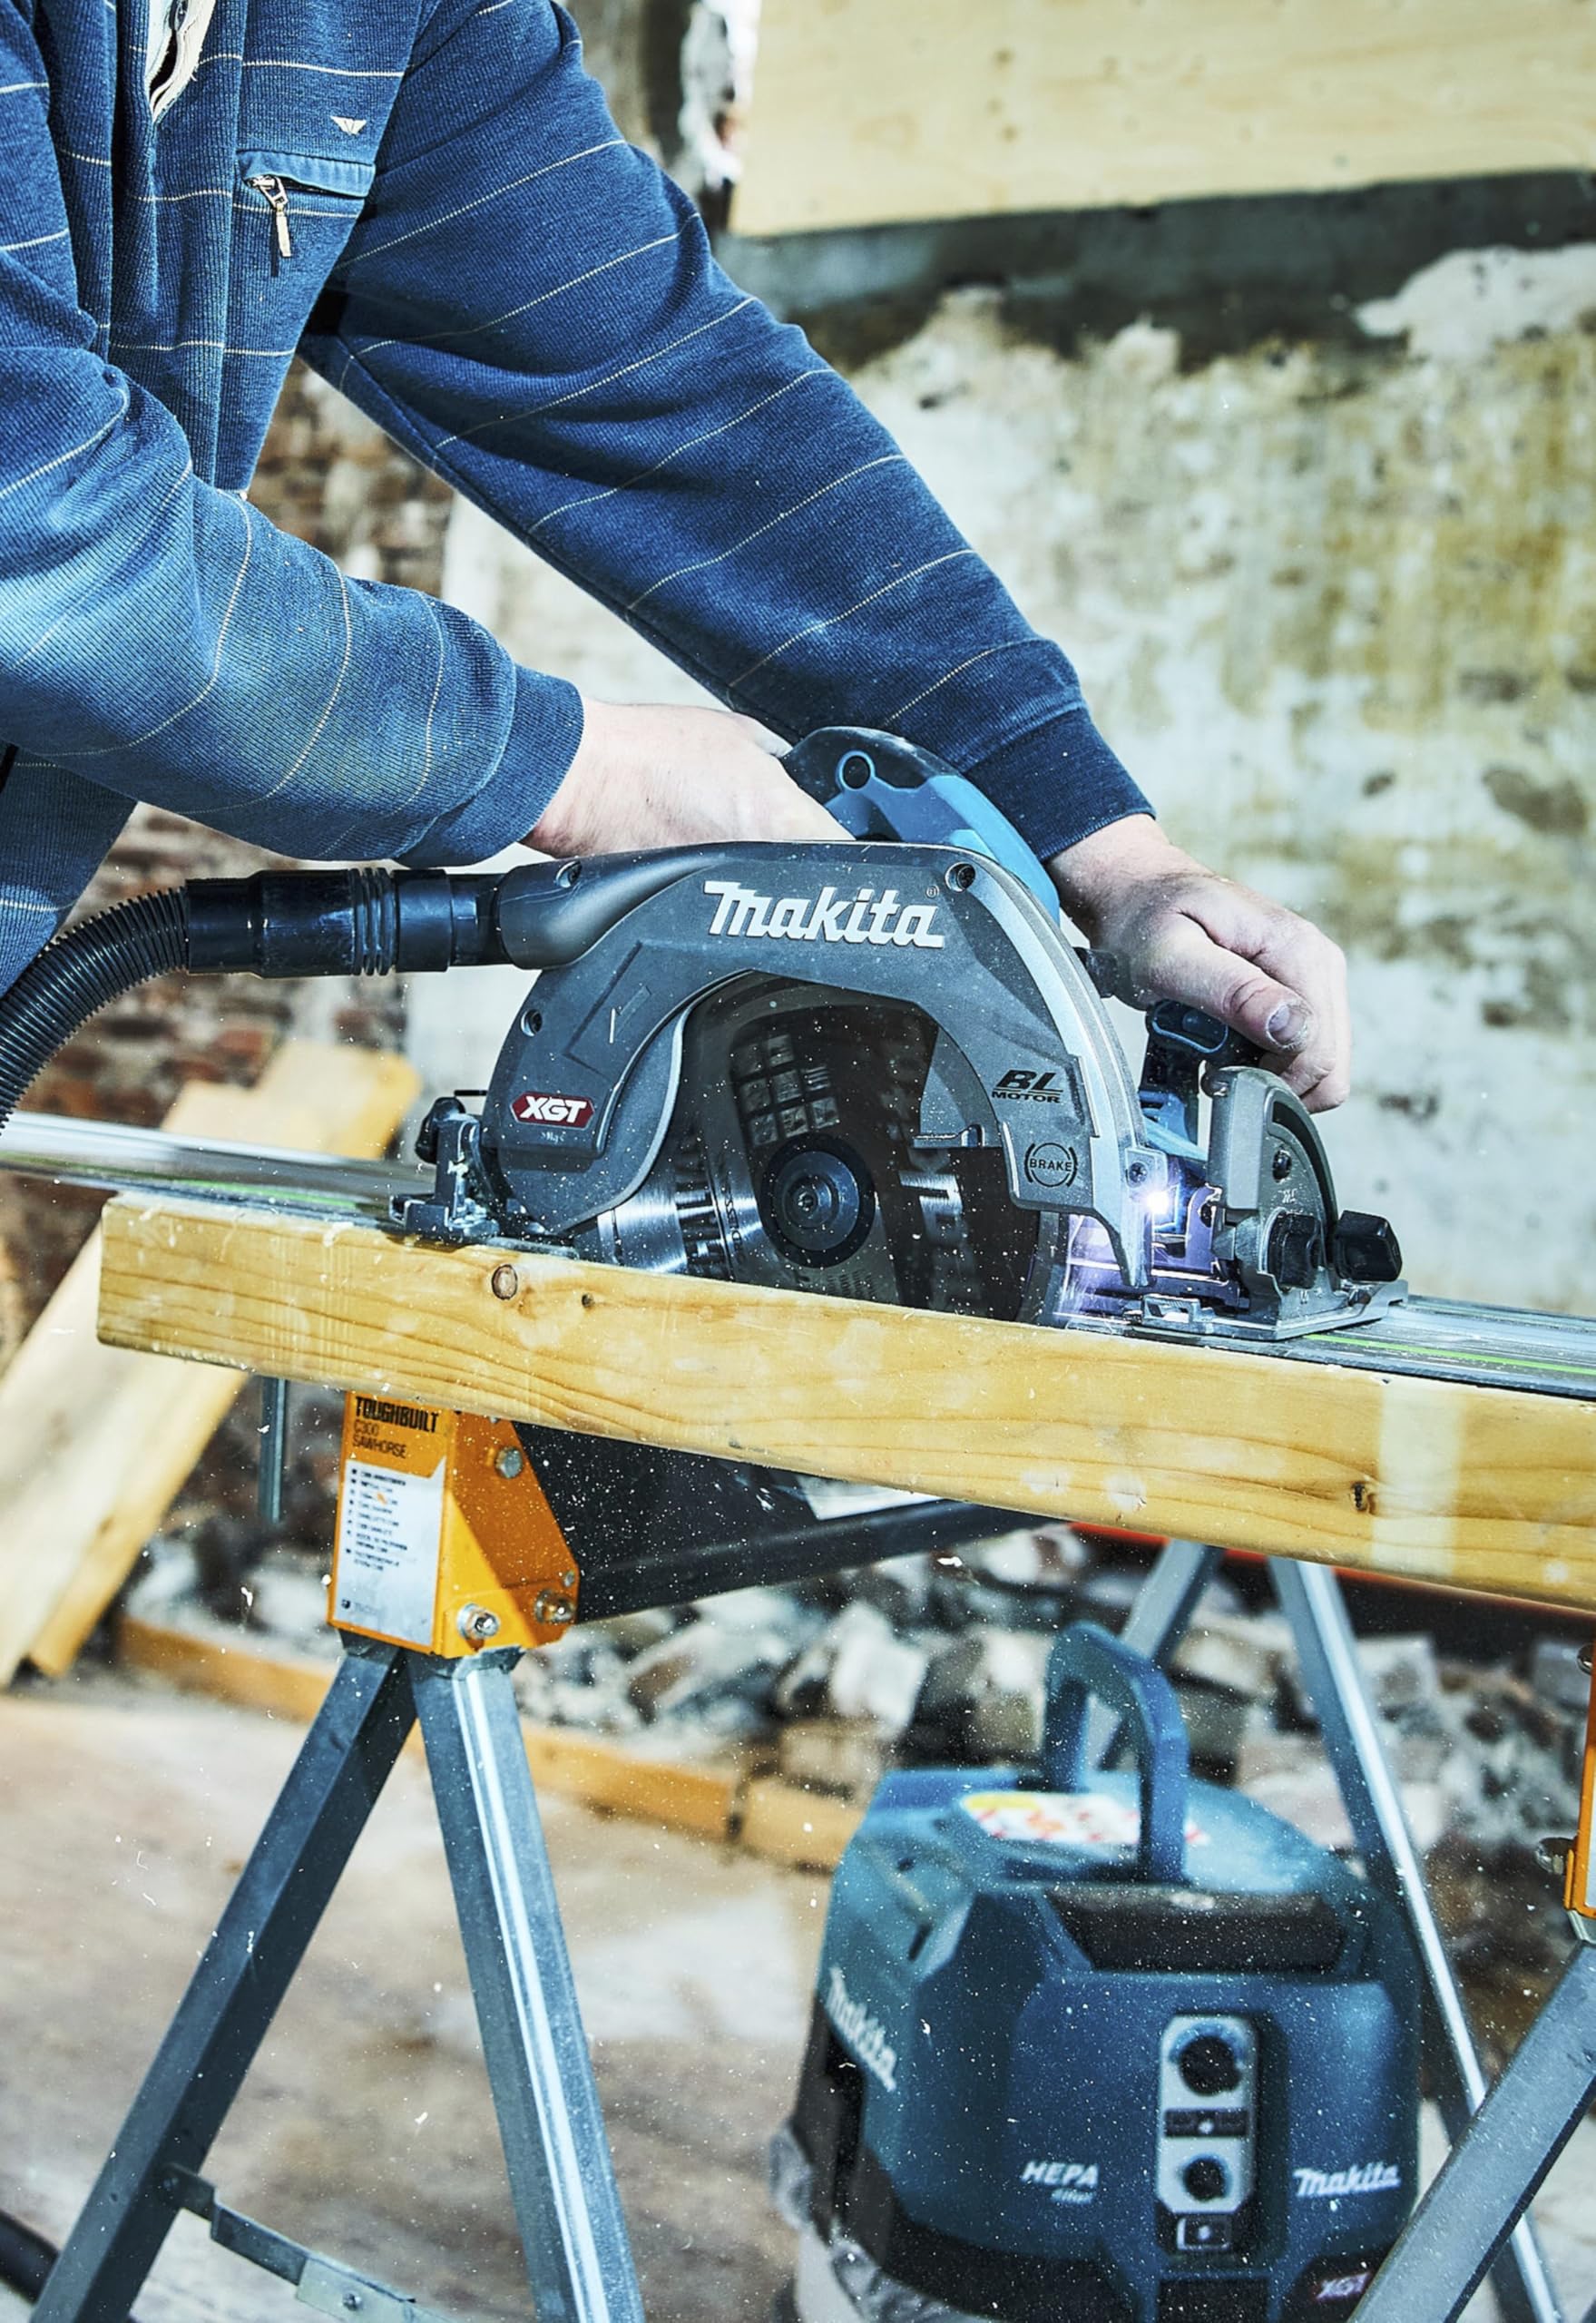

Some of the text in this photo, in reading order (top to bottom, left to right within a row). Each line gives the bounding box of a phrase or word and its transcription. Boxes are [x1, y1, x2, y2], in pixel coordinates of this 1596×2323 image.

[994, 1069, 1063, 1093] BL
[520, 1095, 587, 1123] XGT
[992, 1091, 1061, 1104] MOTOR
[1029, 1157, 1072, 1171] BRAKE
[355, 1396, 439, 1434] TOUGHBUILT
[1020, 2161, 1099, 2188] HEPA
